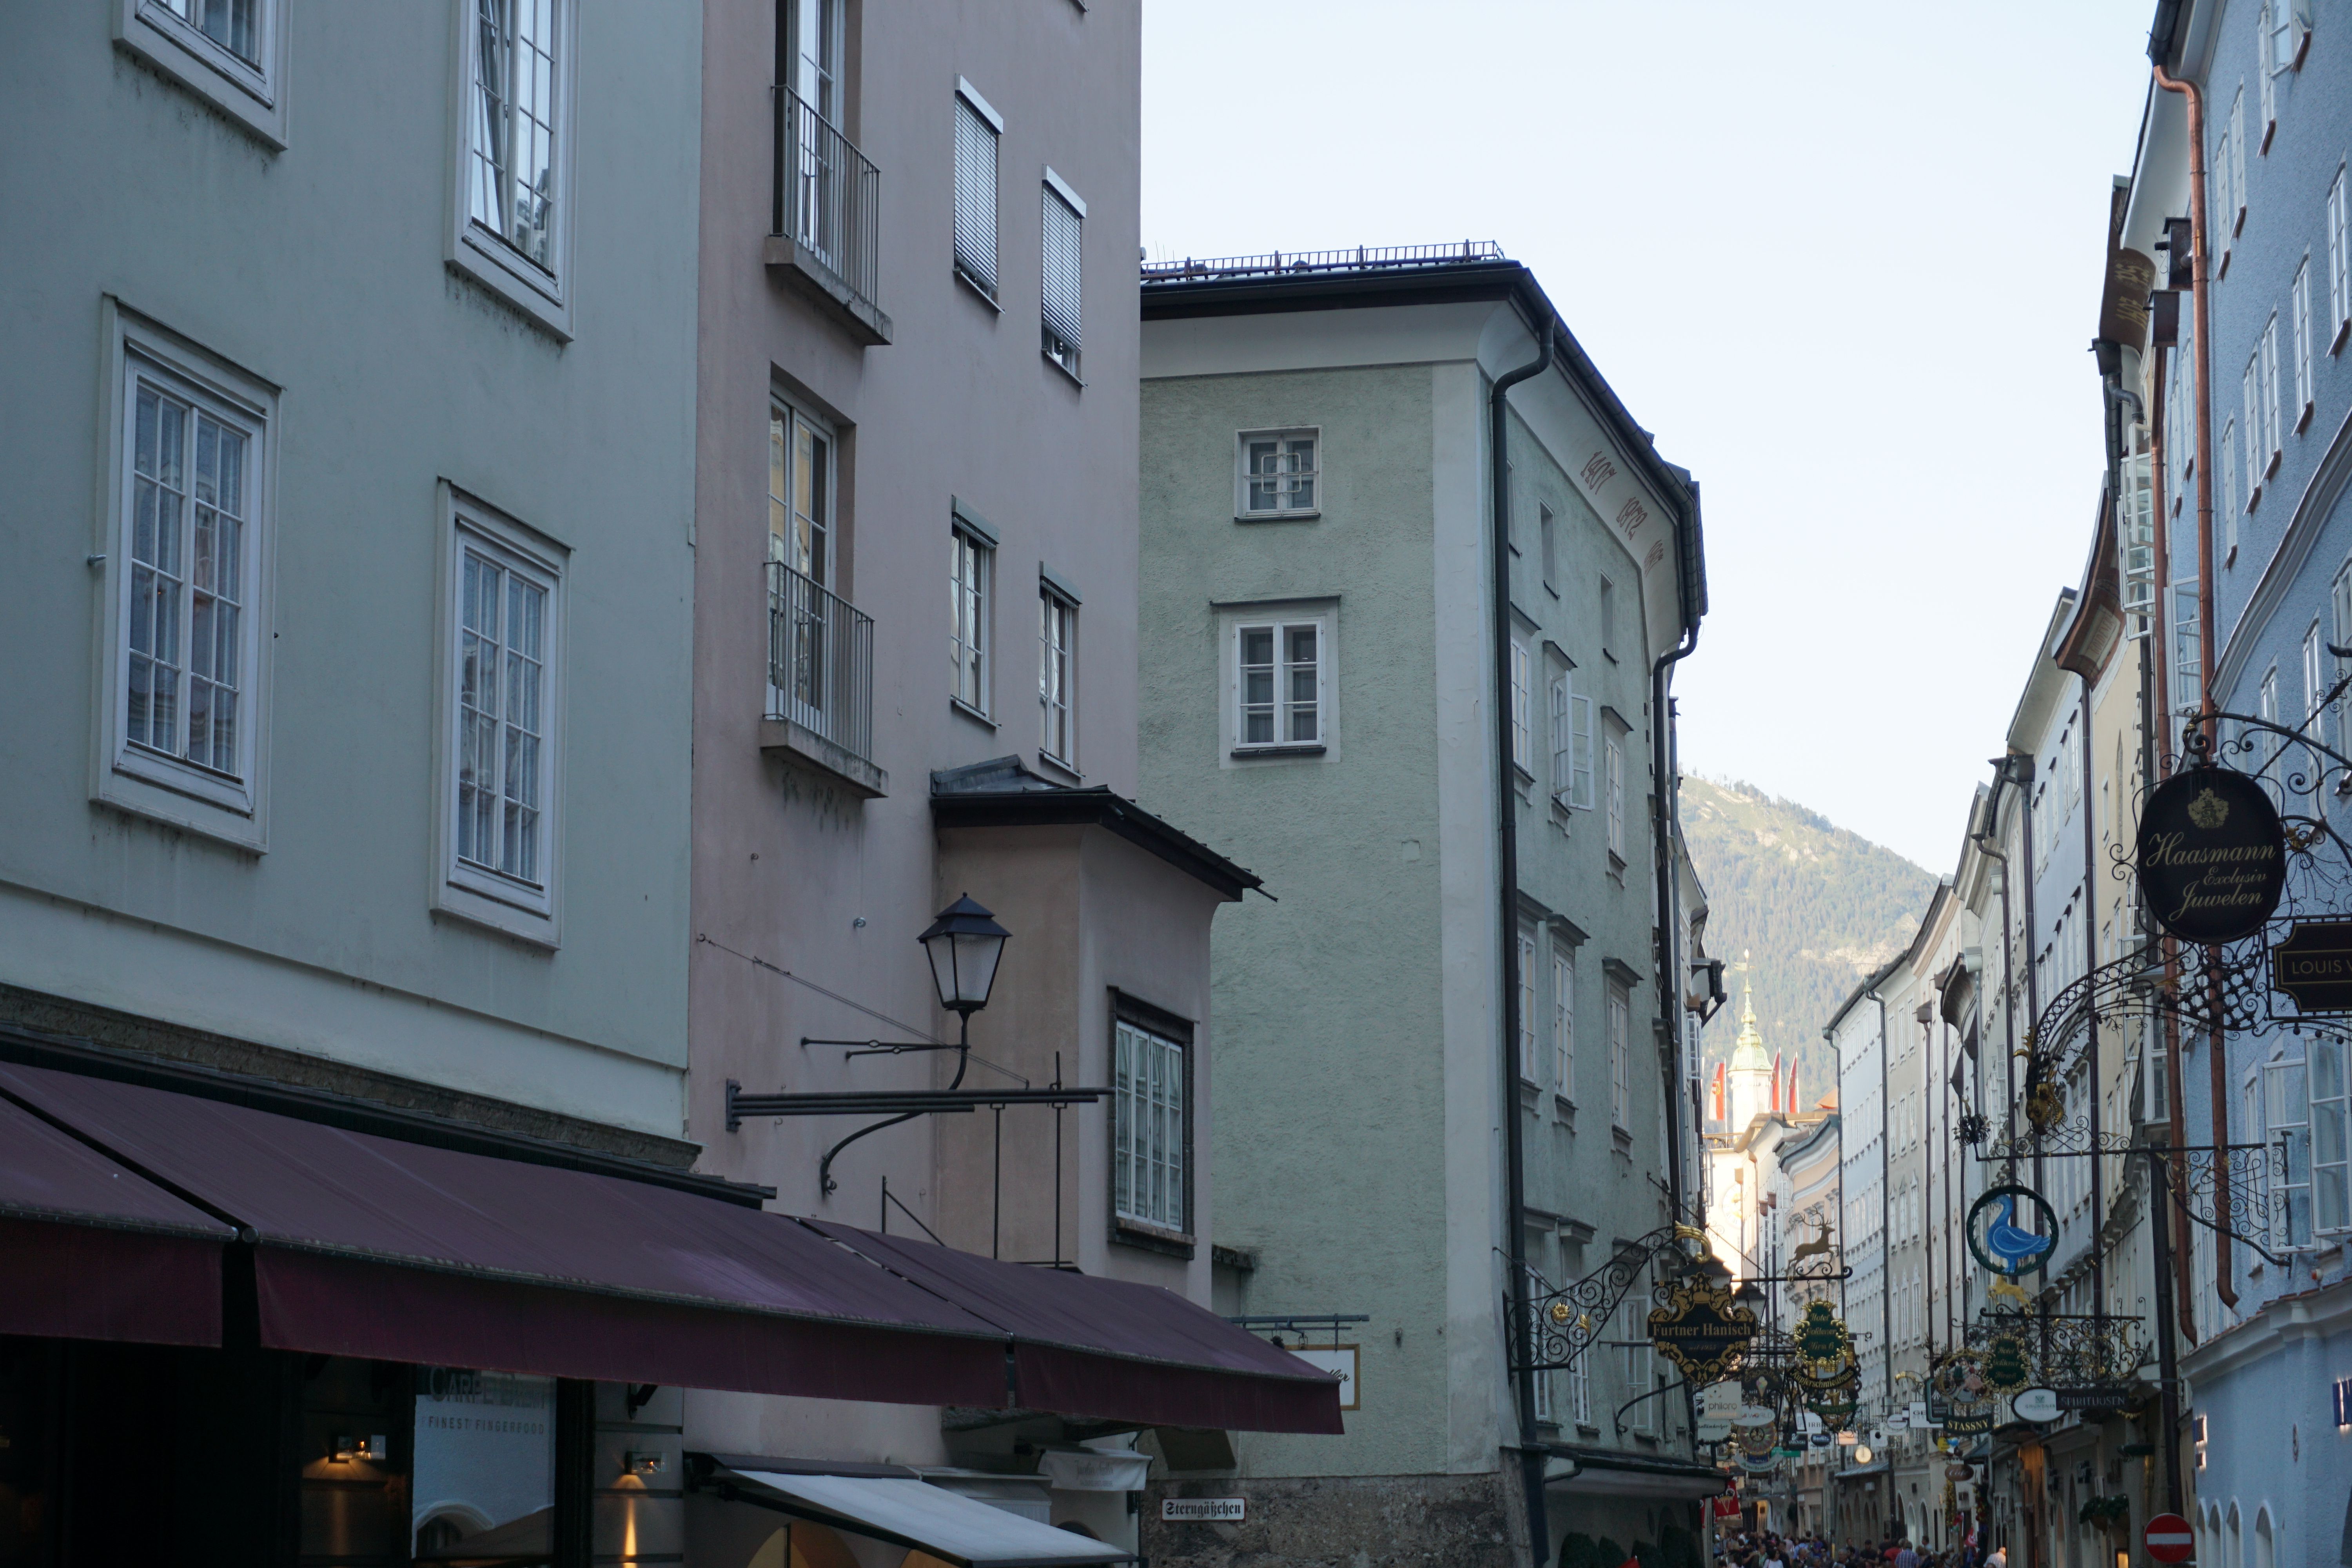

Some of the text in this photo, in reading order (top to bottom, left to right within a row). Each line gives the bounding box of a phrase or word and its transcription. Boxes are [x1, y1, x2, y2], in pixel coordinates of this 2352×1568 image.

[2146, 831, 2276, 867] Haasmann
[2203, 866, 2267, 886] Exclusiv
[2169, 880, 2264, 921] Juwelen
[2292, 960, 2342, 974] LOUIS
[1810, 1313, 1830, 1321] Hotel
[1653, 1323, 1751, 1336] Furtner Hanisch
[1790, 1369, 1854, 1388] Kupferschmiedhaus
[1709, 1402, 1737, 1411] philoro
[2061, 1396, 2125, 1406] SPIRITUOSEN
[429, 1416, 544, 1434] FINEST FINGERFOOD
[1947, 1419, 1989, 1431] STASSNY
[1165, 1500, 1241, 1518] Sterngäßchen
